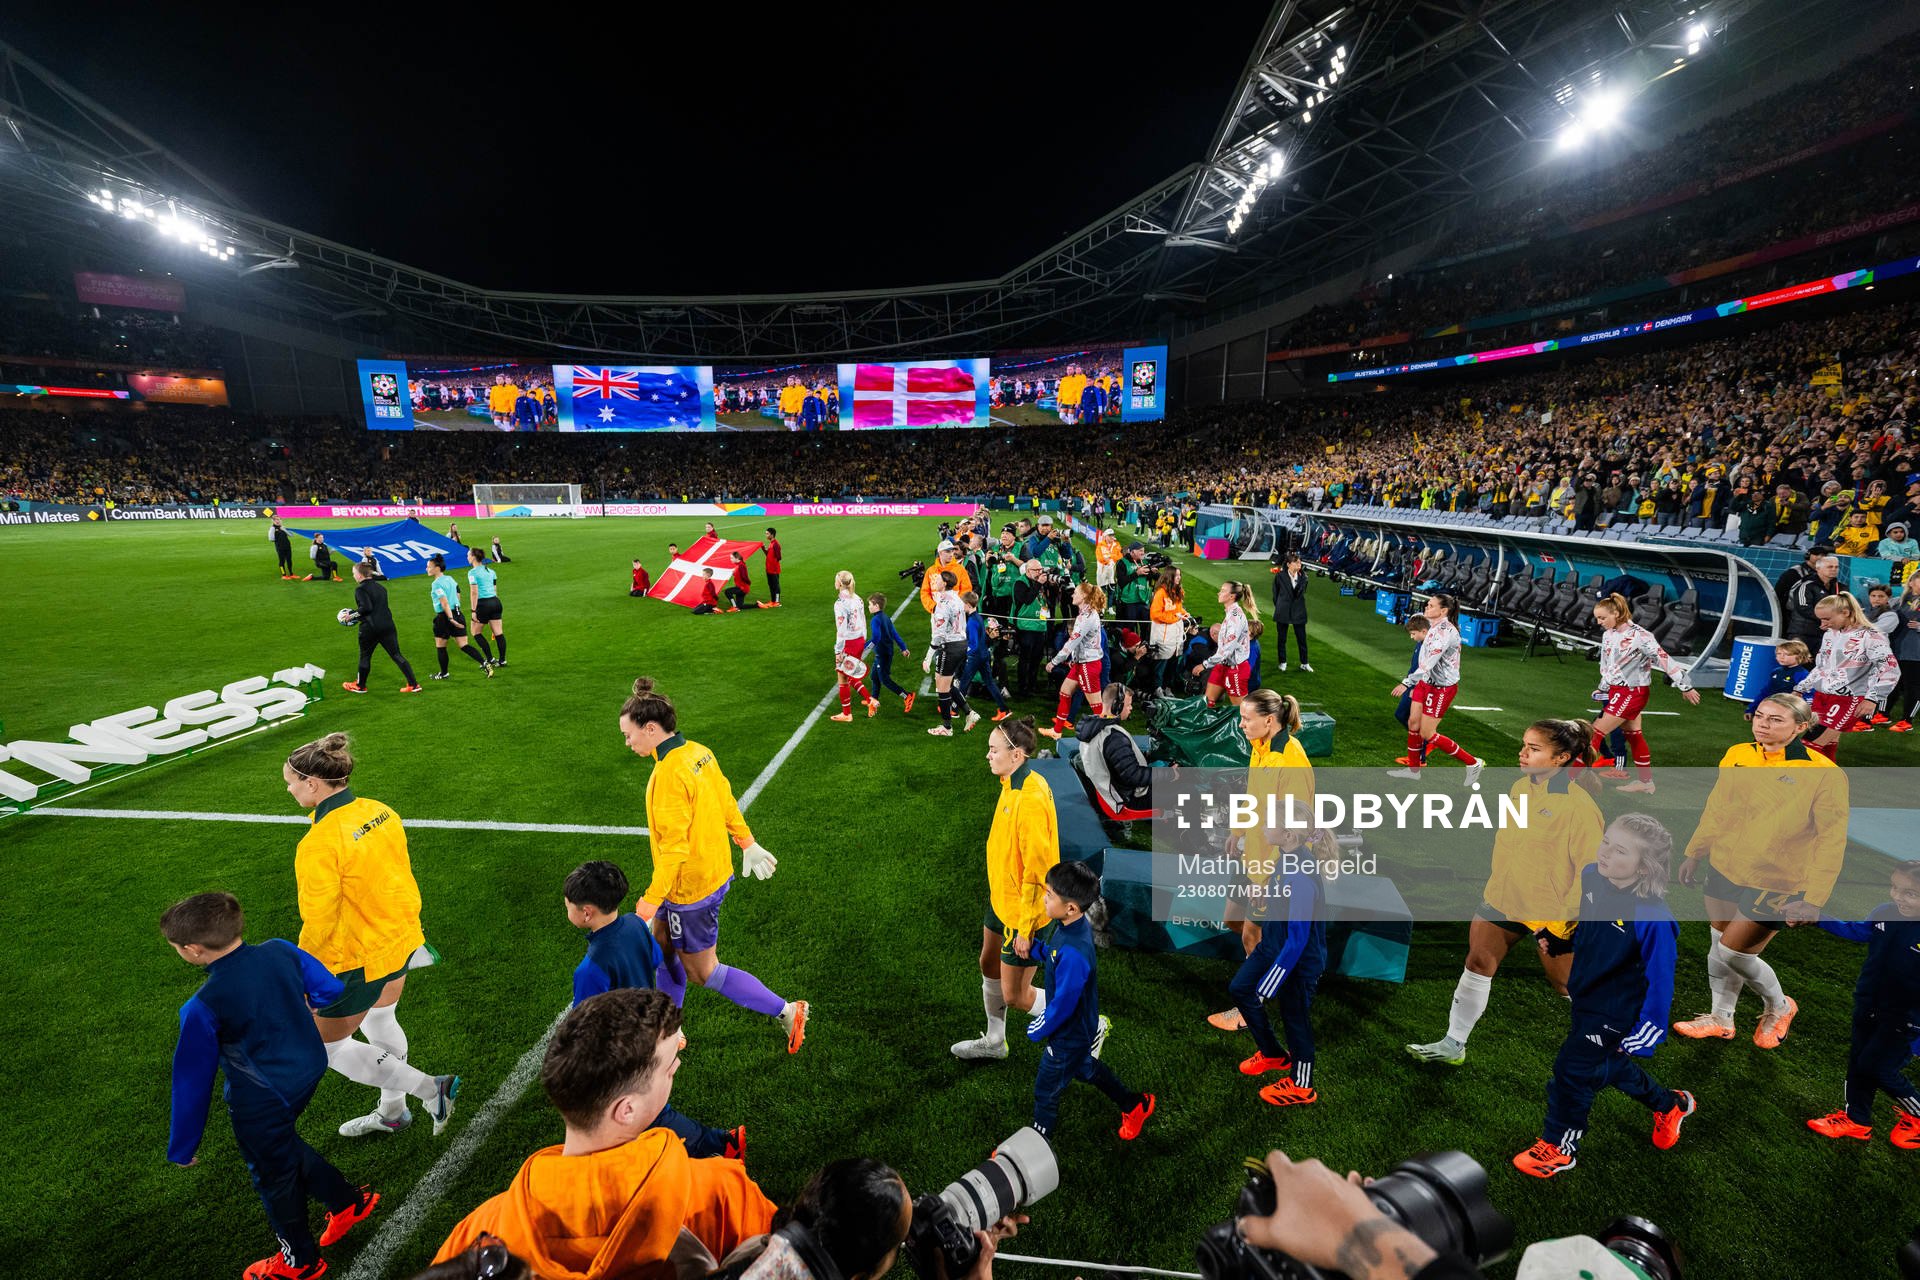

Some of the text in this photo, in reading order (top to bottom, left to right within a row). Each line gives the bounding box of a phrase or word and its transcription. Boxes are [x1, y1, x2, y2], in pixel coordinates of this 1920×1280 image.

[1816, 221, 1872, 245] BEYOND
[1581, 329, 1620, 343] AUSTRALIA
[1655, 314, 1693, 329] DENMARK
[1354, 368, 1385, 377] AUSTRALIA
[1410, 361, 1438, 370] DENMARK
[111, 508, 257, 520] CommBank Mini Mates
[331, 507, 380, 517] BEYOND
[793, 505, 844, 515] BEYOND
[0, 511, 80, 525] Mini Mates
[339, 540, 450, 563] FIFA
[1733, 645, 1753, 697] POWERADE
[1425, 693, 1434, 707] 5
[1826, 703, 1841, 718] 9
